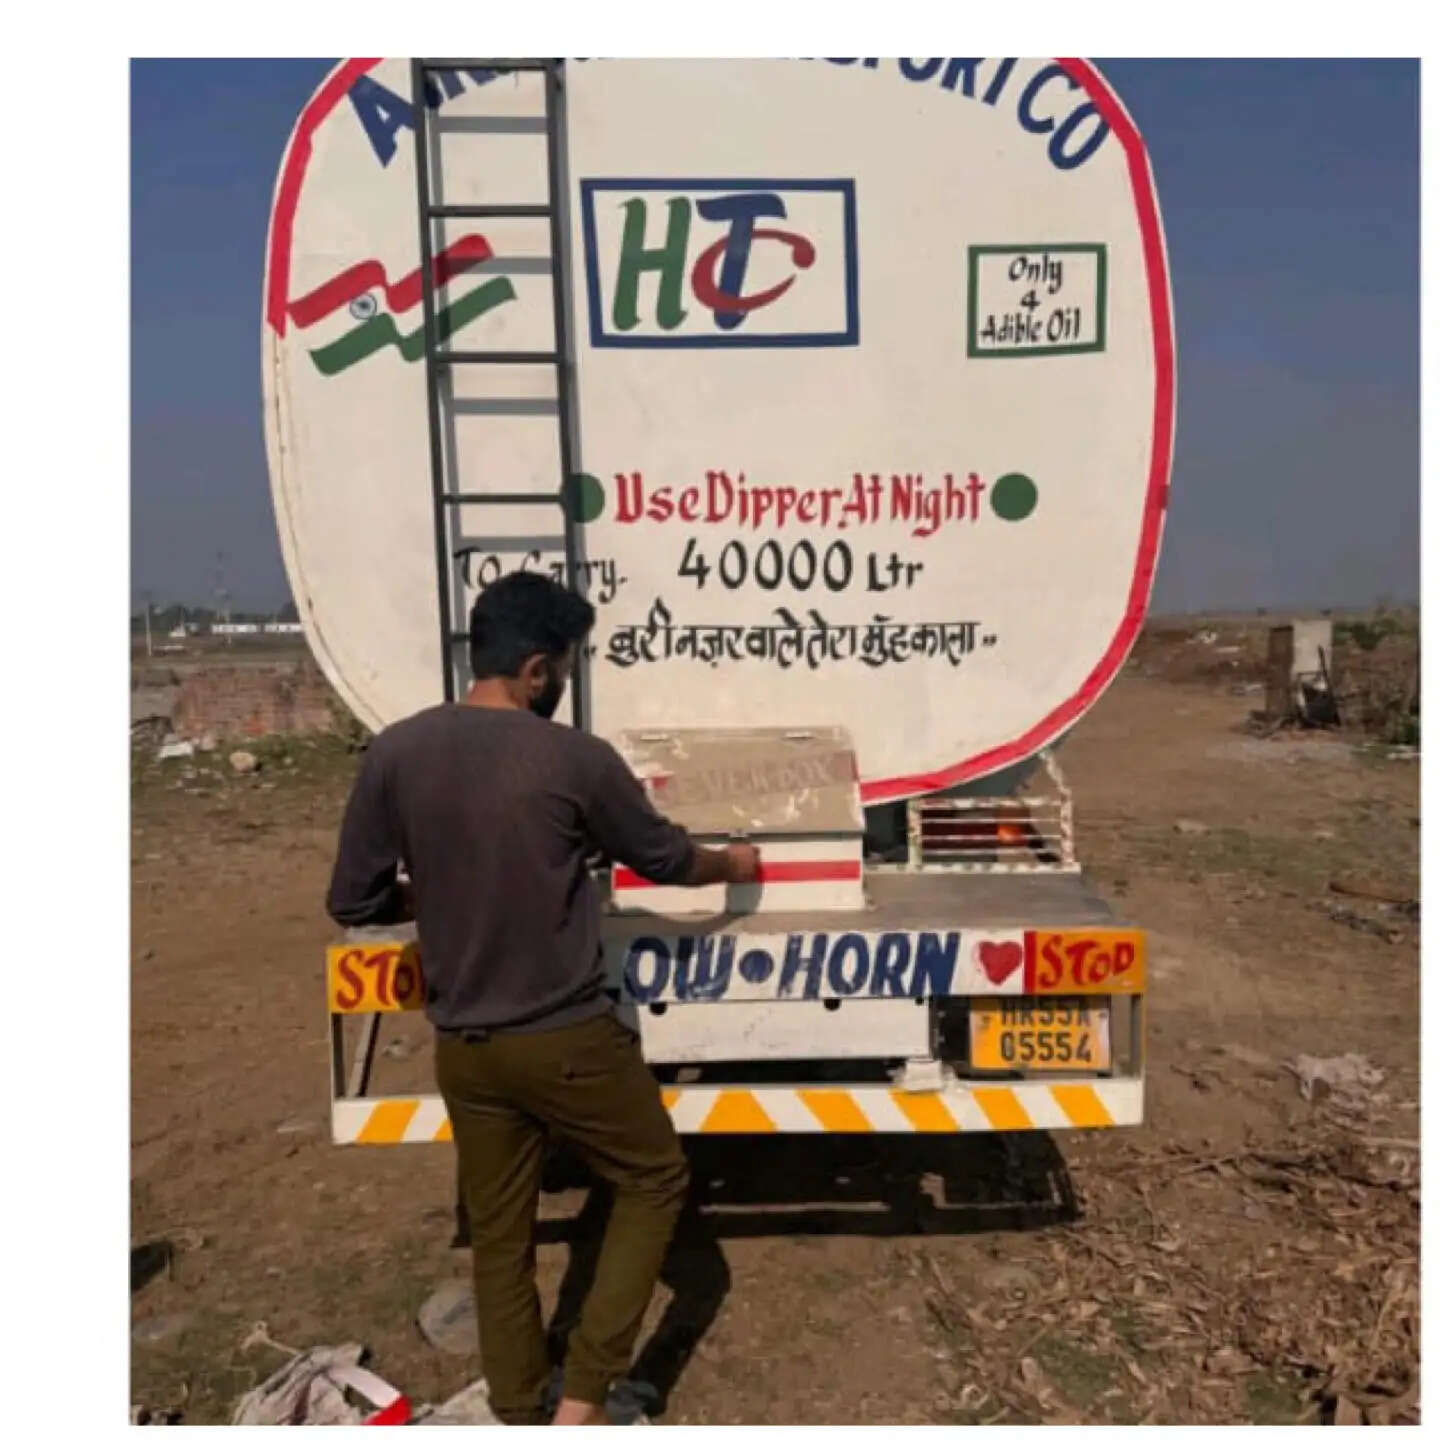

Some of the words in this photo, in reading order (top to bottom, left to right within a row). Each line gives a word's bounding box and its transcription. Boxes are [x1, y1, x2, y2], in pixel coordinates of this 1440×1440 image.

[1008, 251, 1062, 295] Only
[1020, 289, 1042, 312] 4
[1046, 305, 1081, 342] Oil
[614, 471, 701, 523] Use
[889, 472, 986, 537] Night
[677, 537, 853, 592] 40000
[866, 551, 924, 592] Ltr
[336, 948, 425, 1010] STO
[778, 931, 961, 998] HORN
[1001, 1030, 1092, 1063] 05554
